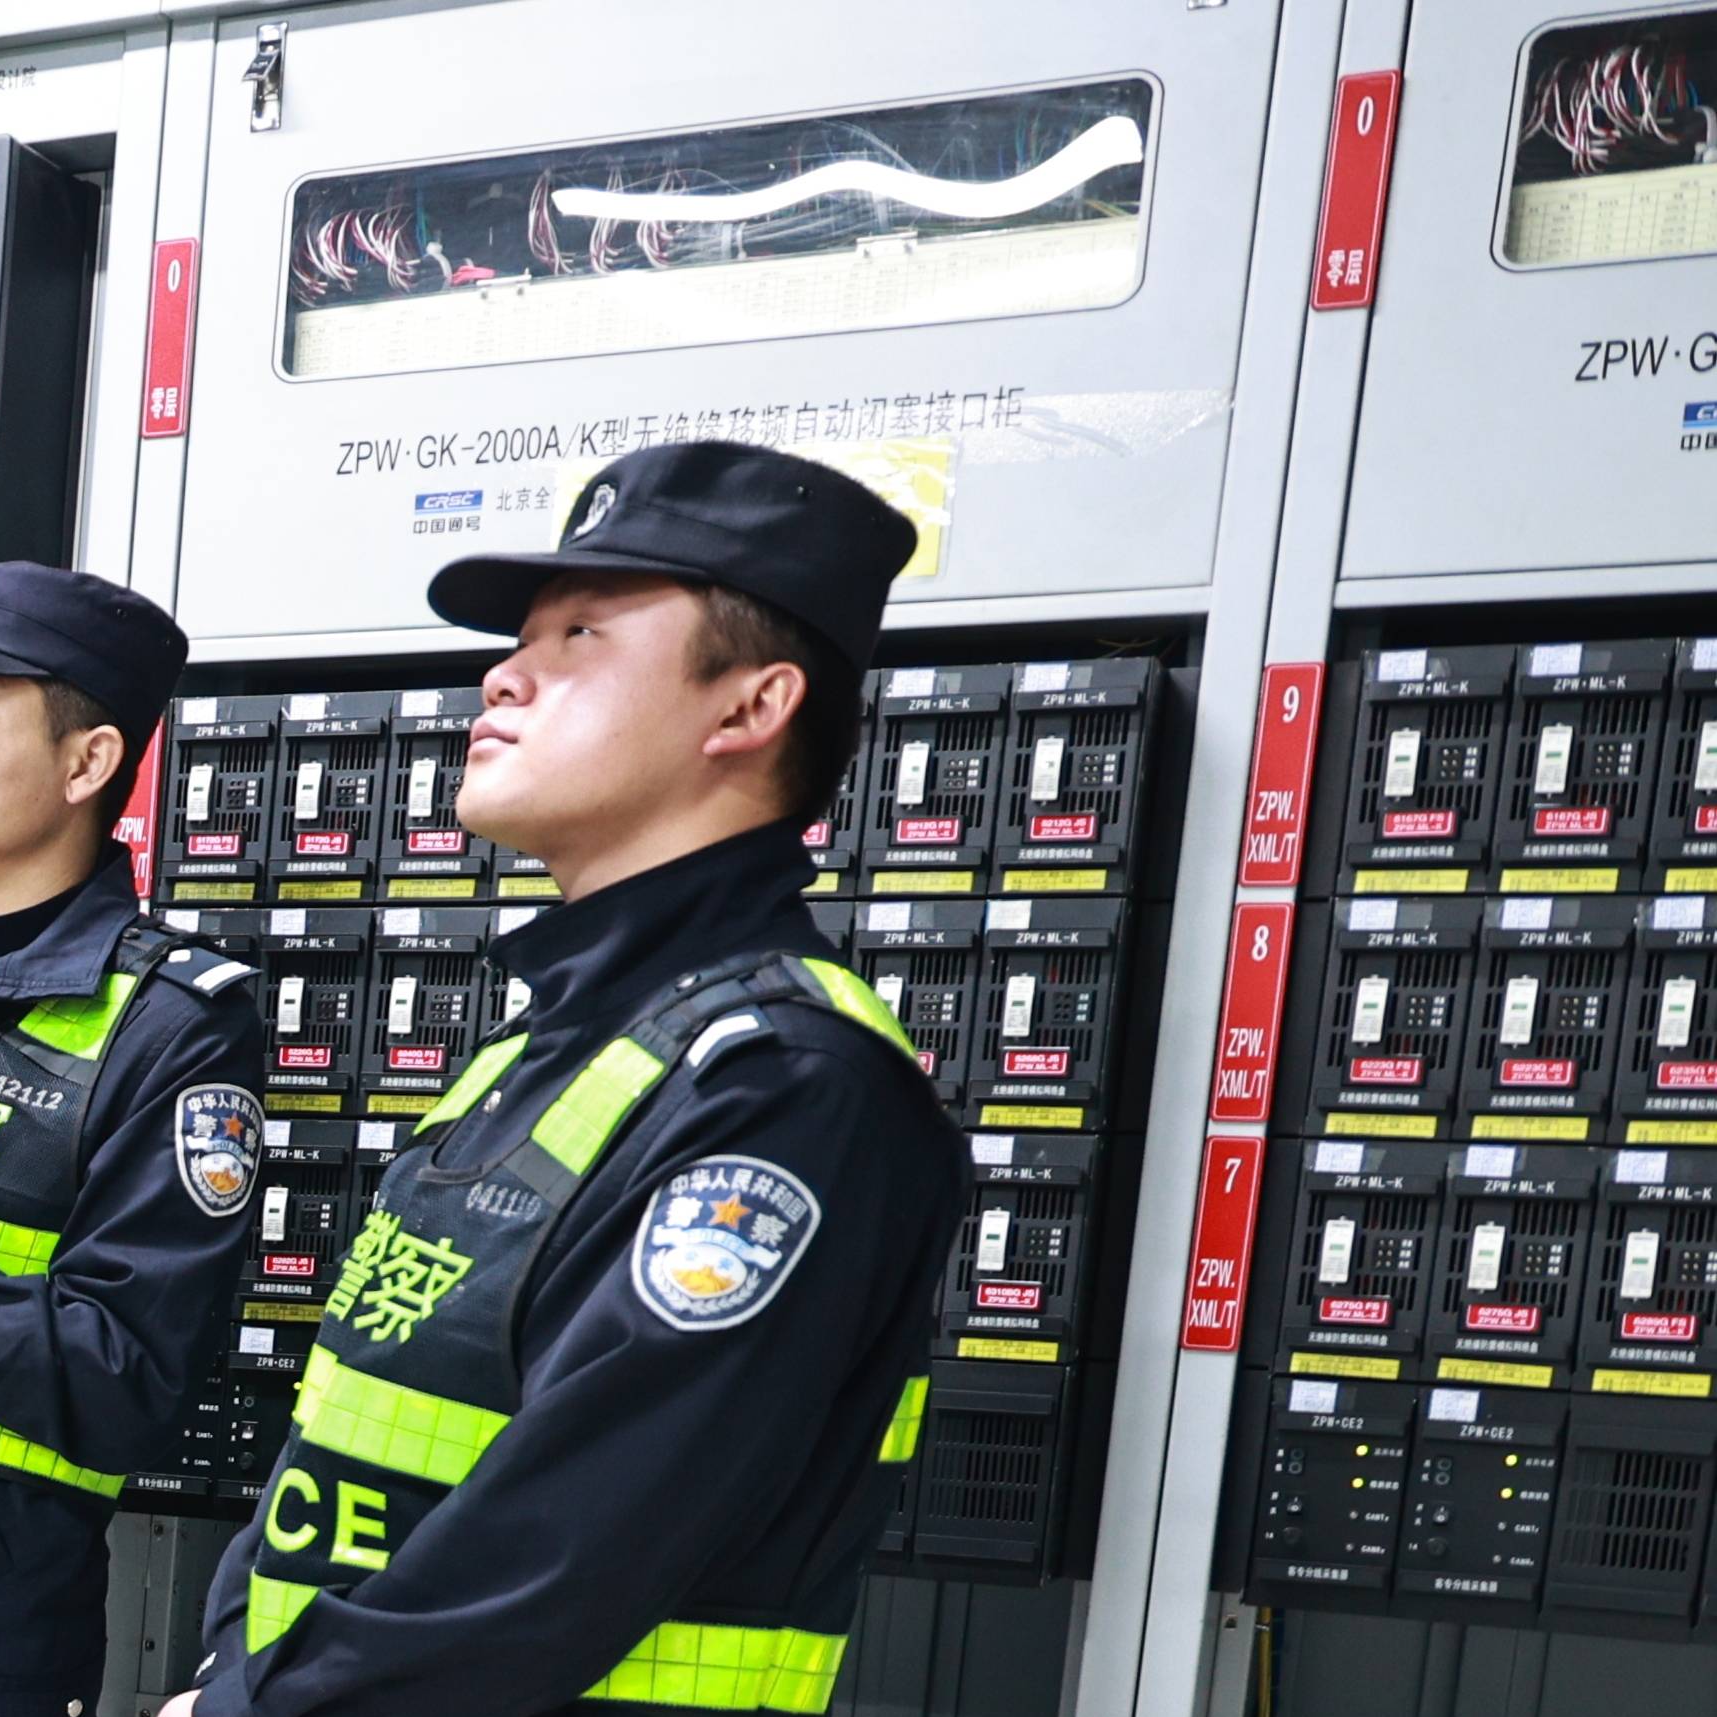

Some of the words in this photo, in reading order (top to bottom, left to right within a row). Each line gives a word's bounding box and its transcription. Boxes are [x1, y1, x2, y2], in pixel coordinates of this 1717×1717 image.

[1357, 96, 1374, 136] 0
[167, 258, 181, 293] 0
[422, 493, 477, 510] CRSC
[413, 517, 481, 535] 中国通号
[1283, 686, 1300, 723] 9
[1247, 832, 1296, 863] XML/T
[1251, 925, 1269, 961] 8
[1218, 1069, 1266, 1099] XML/T
[193, 1113, 219, 1138] 警
[1224, 1158, 1241, 1193] 7
[670, 1168, 809, 1224] 中华人民共和国
[751, 1210, 790, 1248] 察
[1189, 1299, 1236, 1329] XML/T
